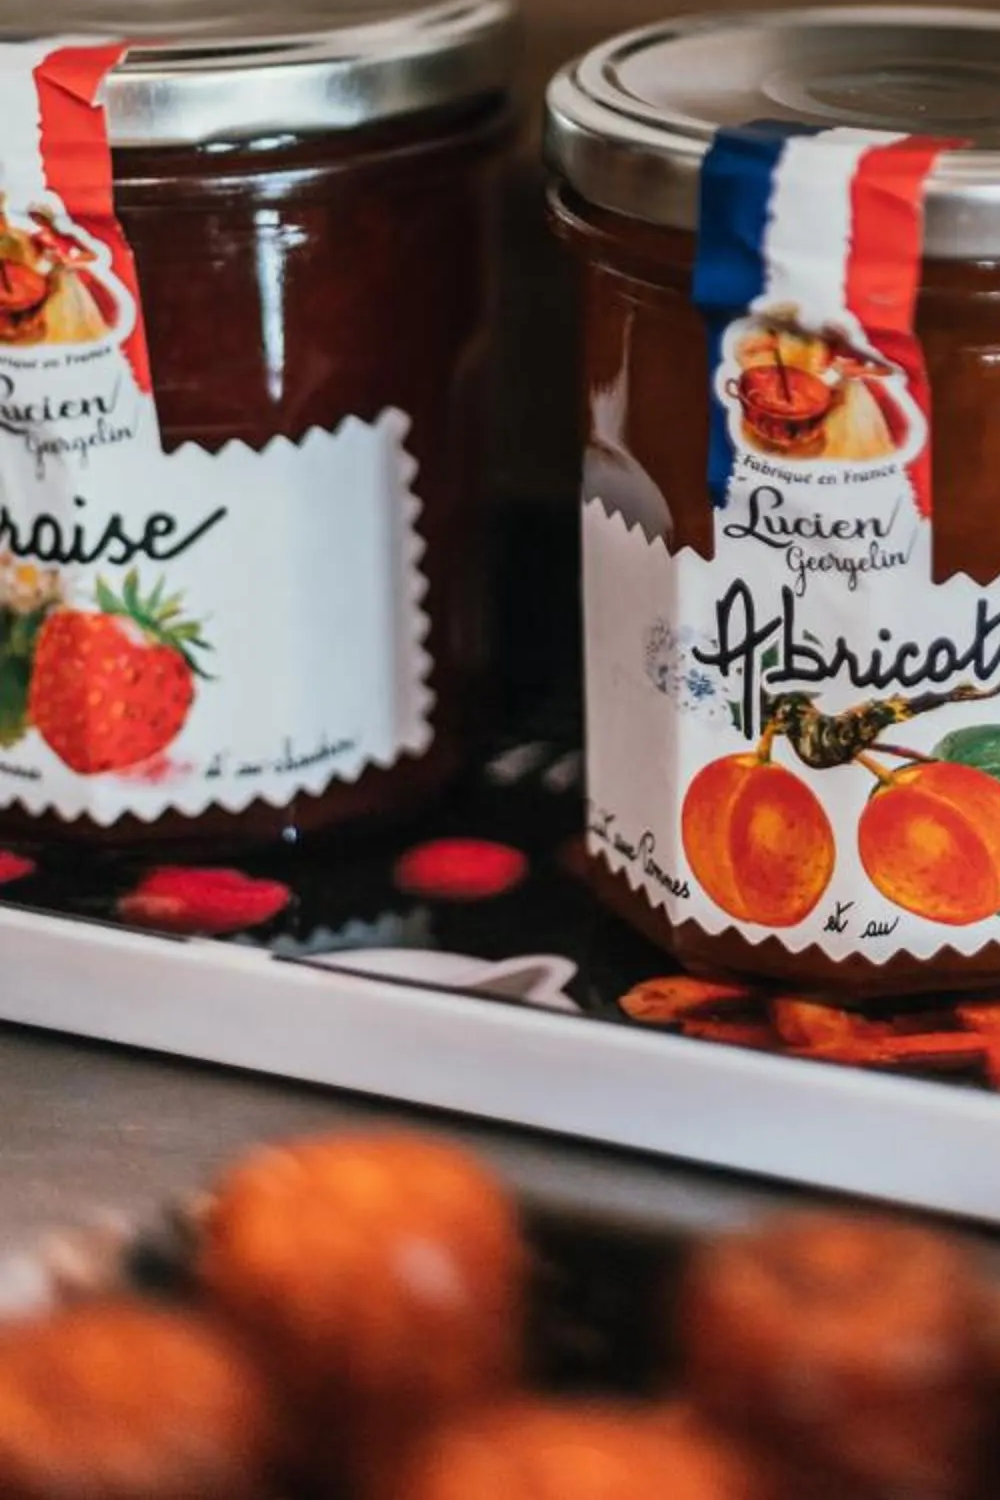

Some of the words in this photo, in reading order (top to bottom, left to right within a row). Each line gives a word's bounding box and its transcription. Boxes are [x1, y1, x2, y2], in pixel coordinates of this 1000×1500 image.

[843, 463, 898, 485] France
[723, 485, 904, 549] Lucien
[786, 528, 918, 597] Georgelin
[824, 901, 853, 933] et
[860, 916, 899, 938] au
